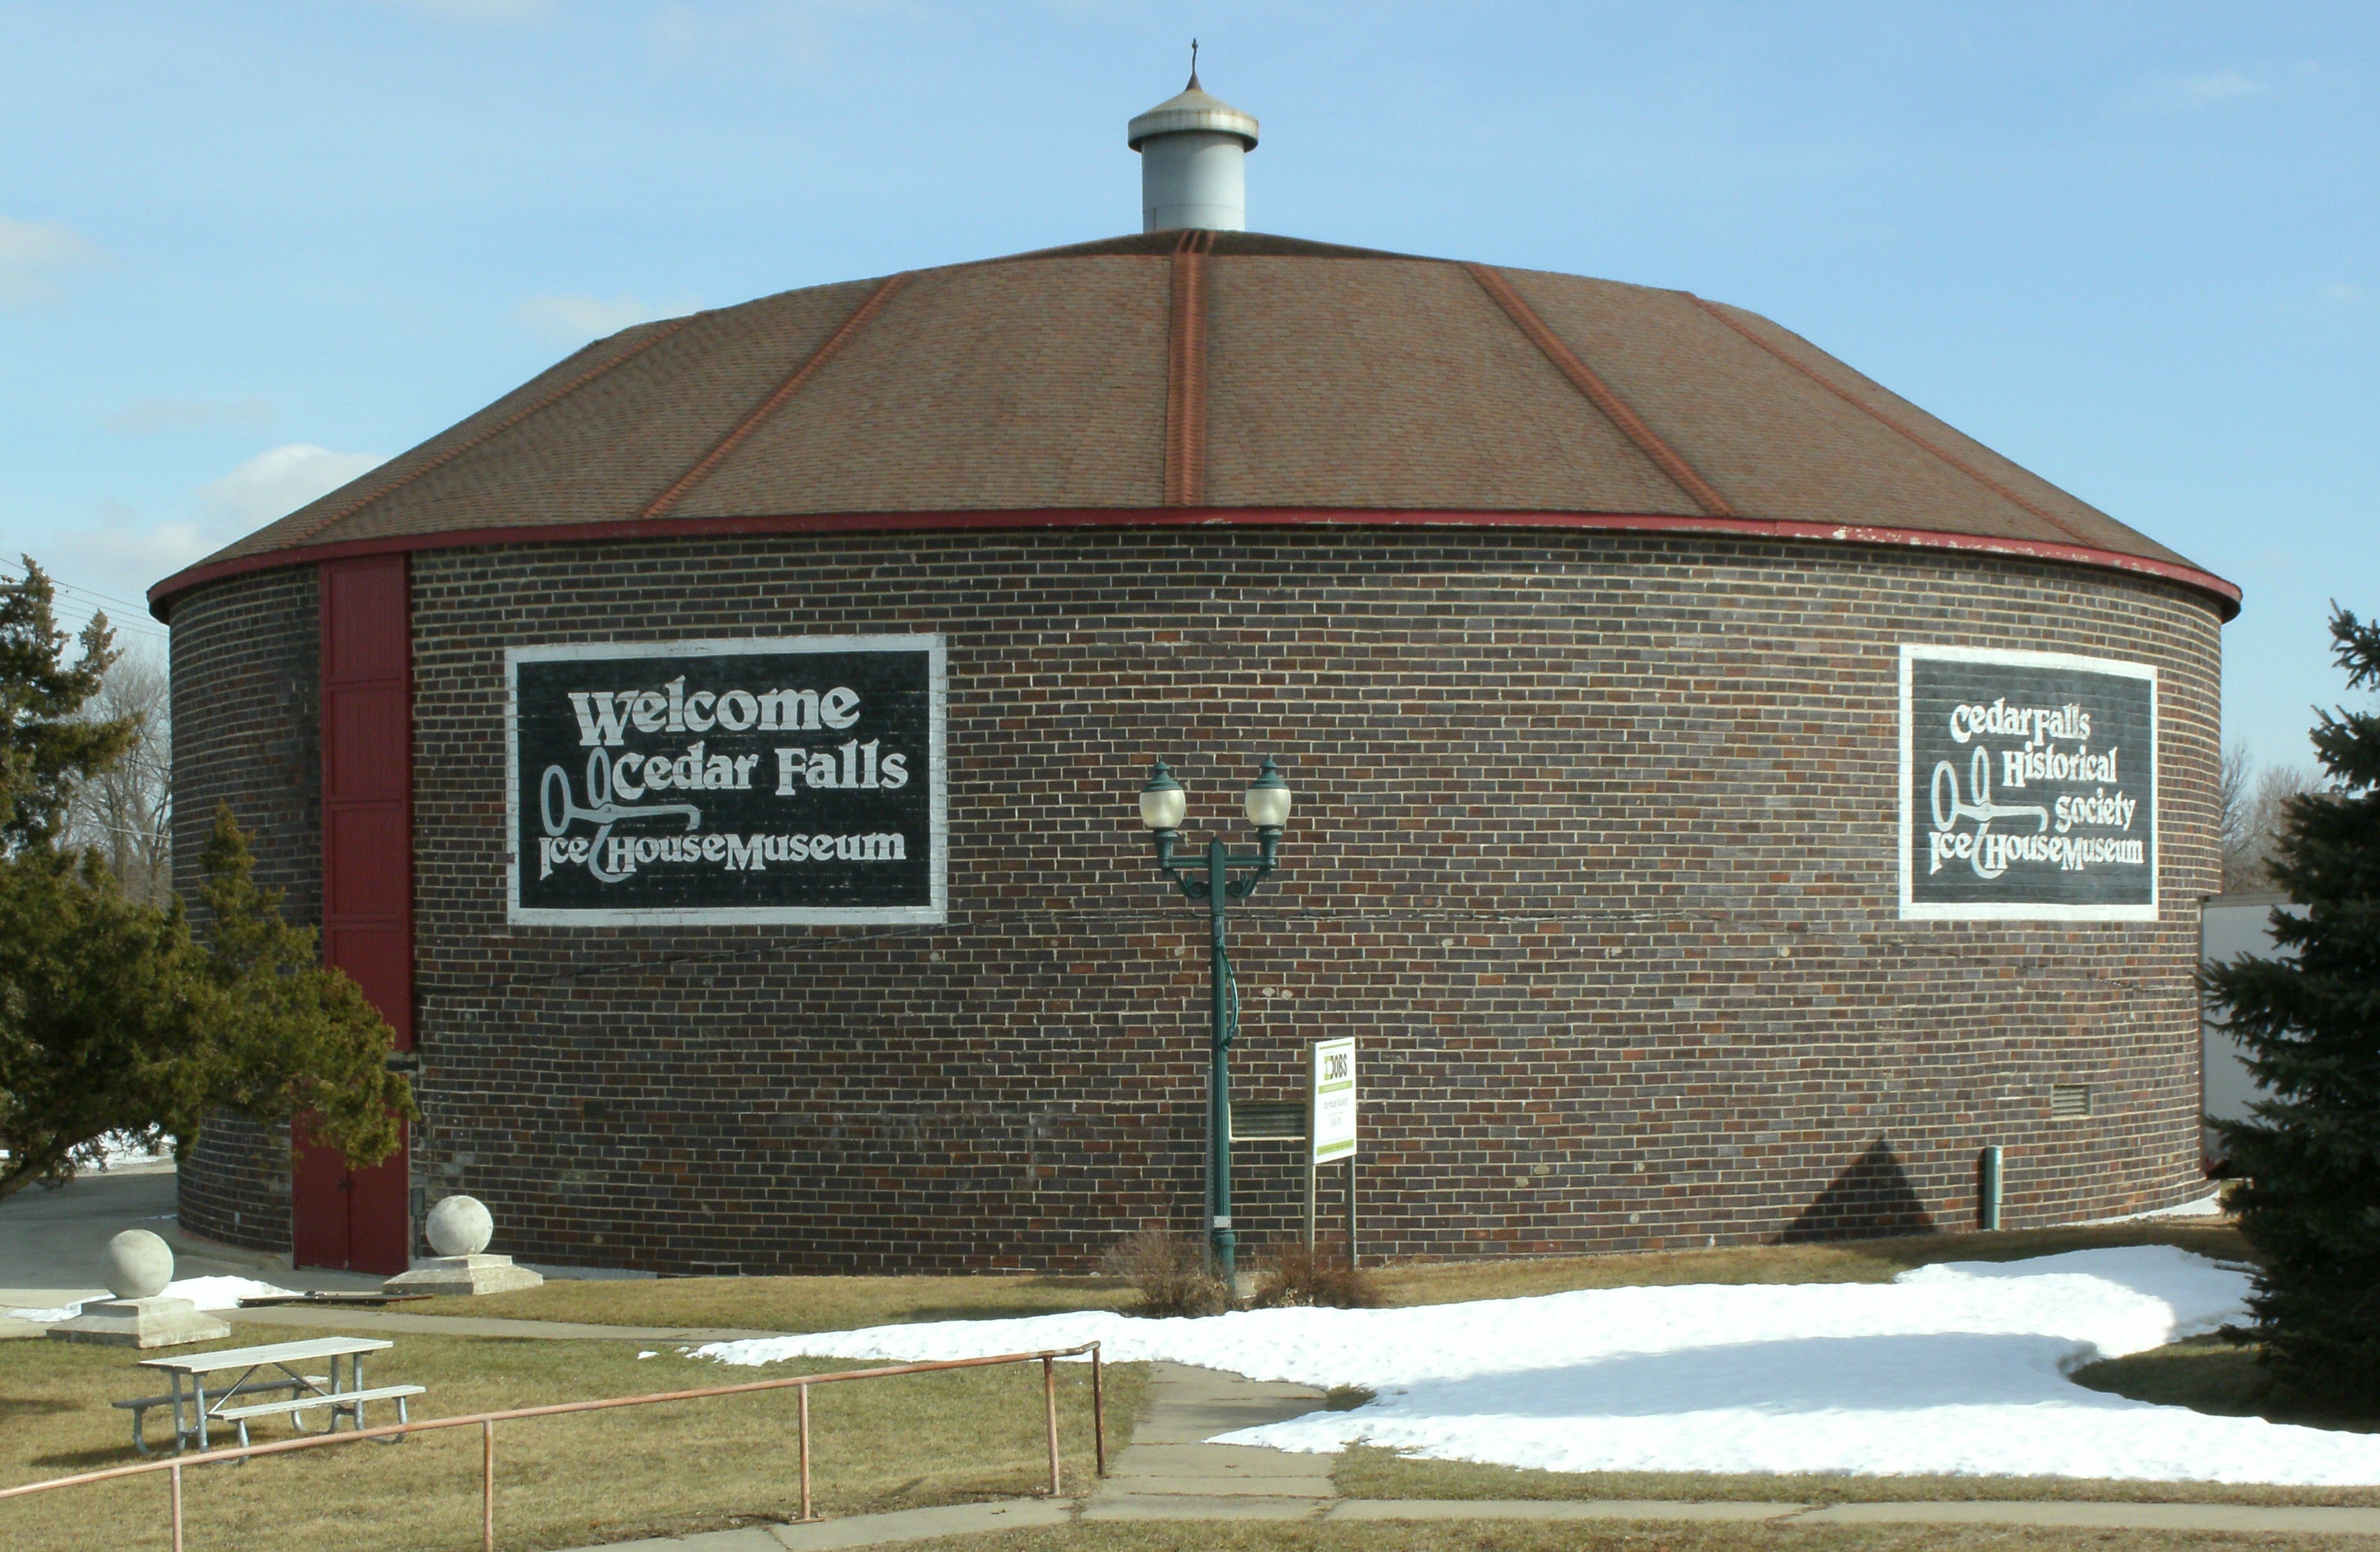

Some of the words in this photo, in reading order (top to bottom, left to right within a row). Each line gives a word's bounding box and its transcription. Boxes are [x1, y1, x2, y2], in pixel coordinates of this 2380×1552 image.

[568, 675, 860, 746] Welcome
[1950, 697, 2033, 743] Cedar
[2032, 703, 2091, 745] Falls
[611, 740, 759, 800] Cedar
[775, 738, 908, 796] Falls
[2002, 741, 2117, 787] Historical
[2055, 788, 2136, 833] Society
[539, 836, 590, 881] Ice
[606, 833, 727, 873] House
[725, 832, 907, 871] Museum
[1929, 832, 1972, 875] Ice
[1985, 833, 2064, 869] House
[2062, 837, 2144, 870] Museum
